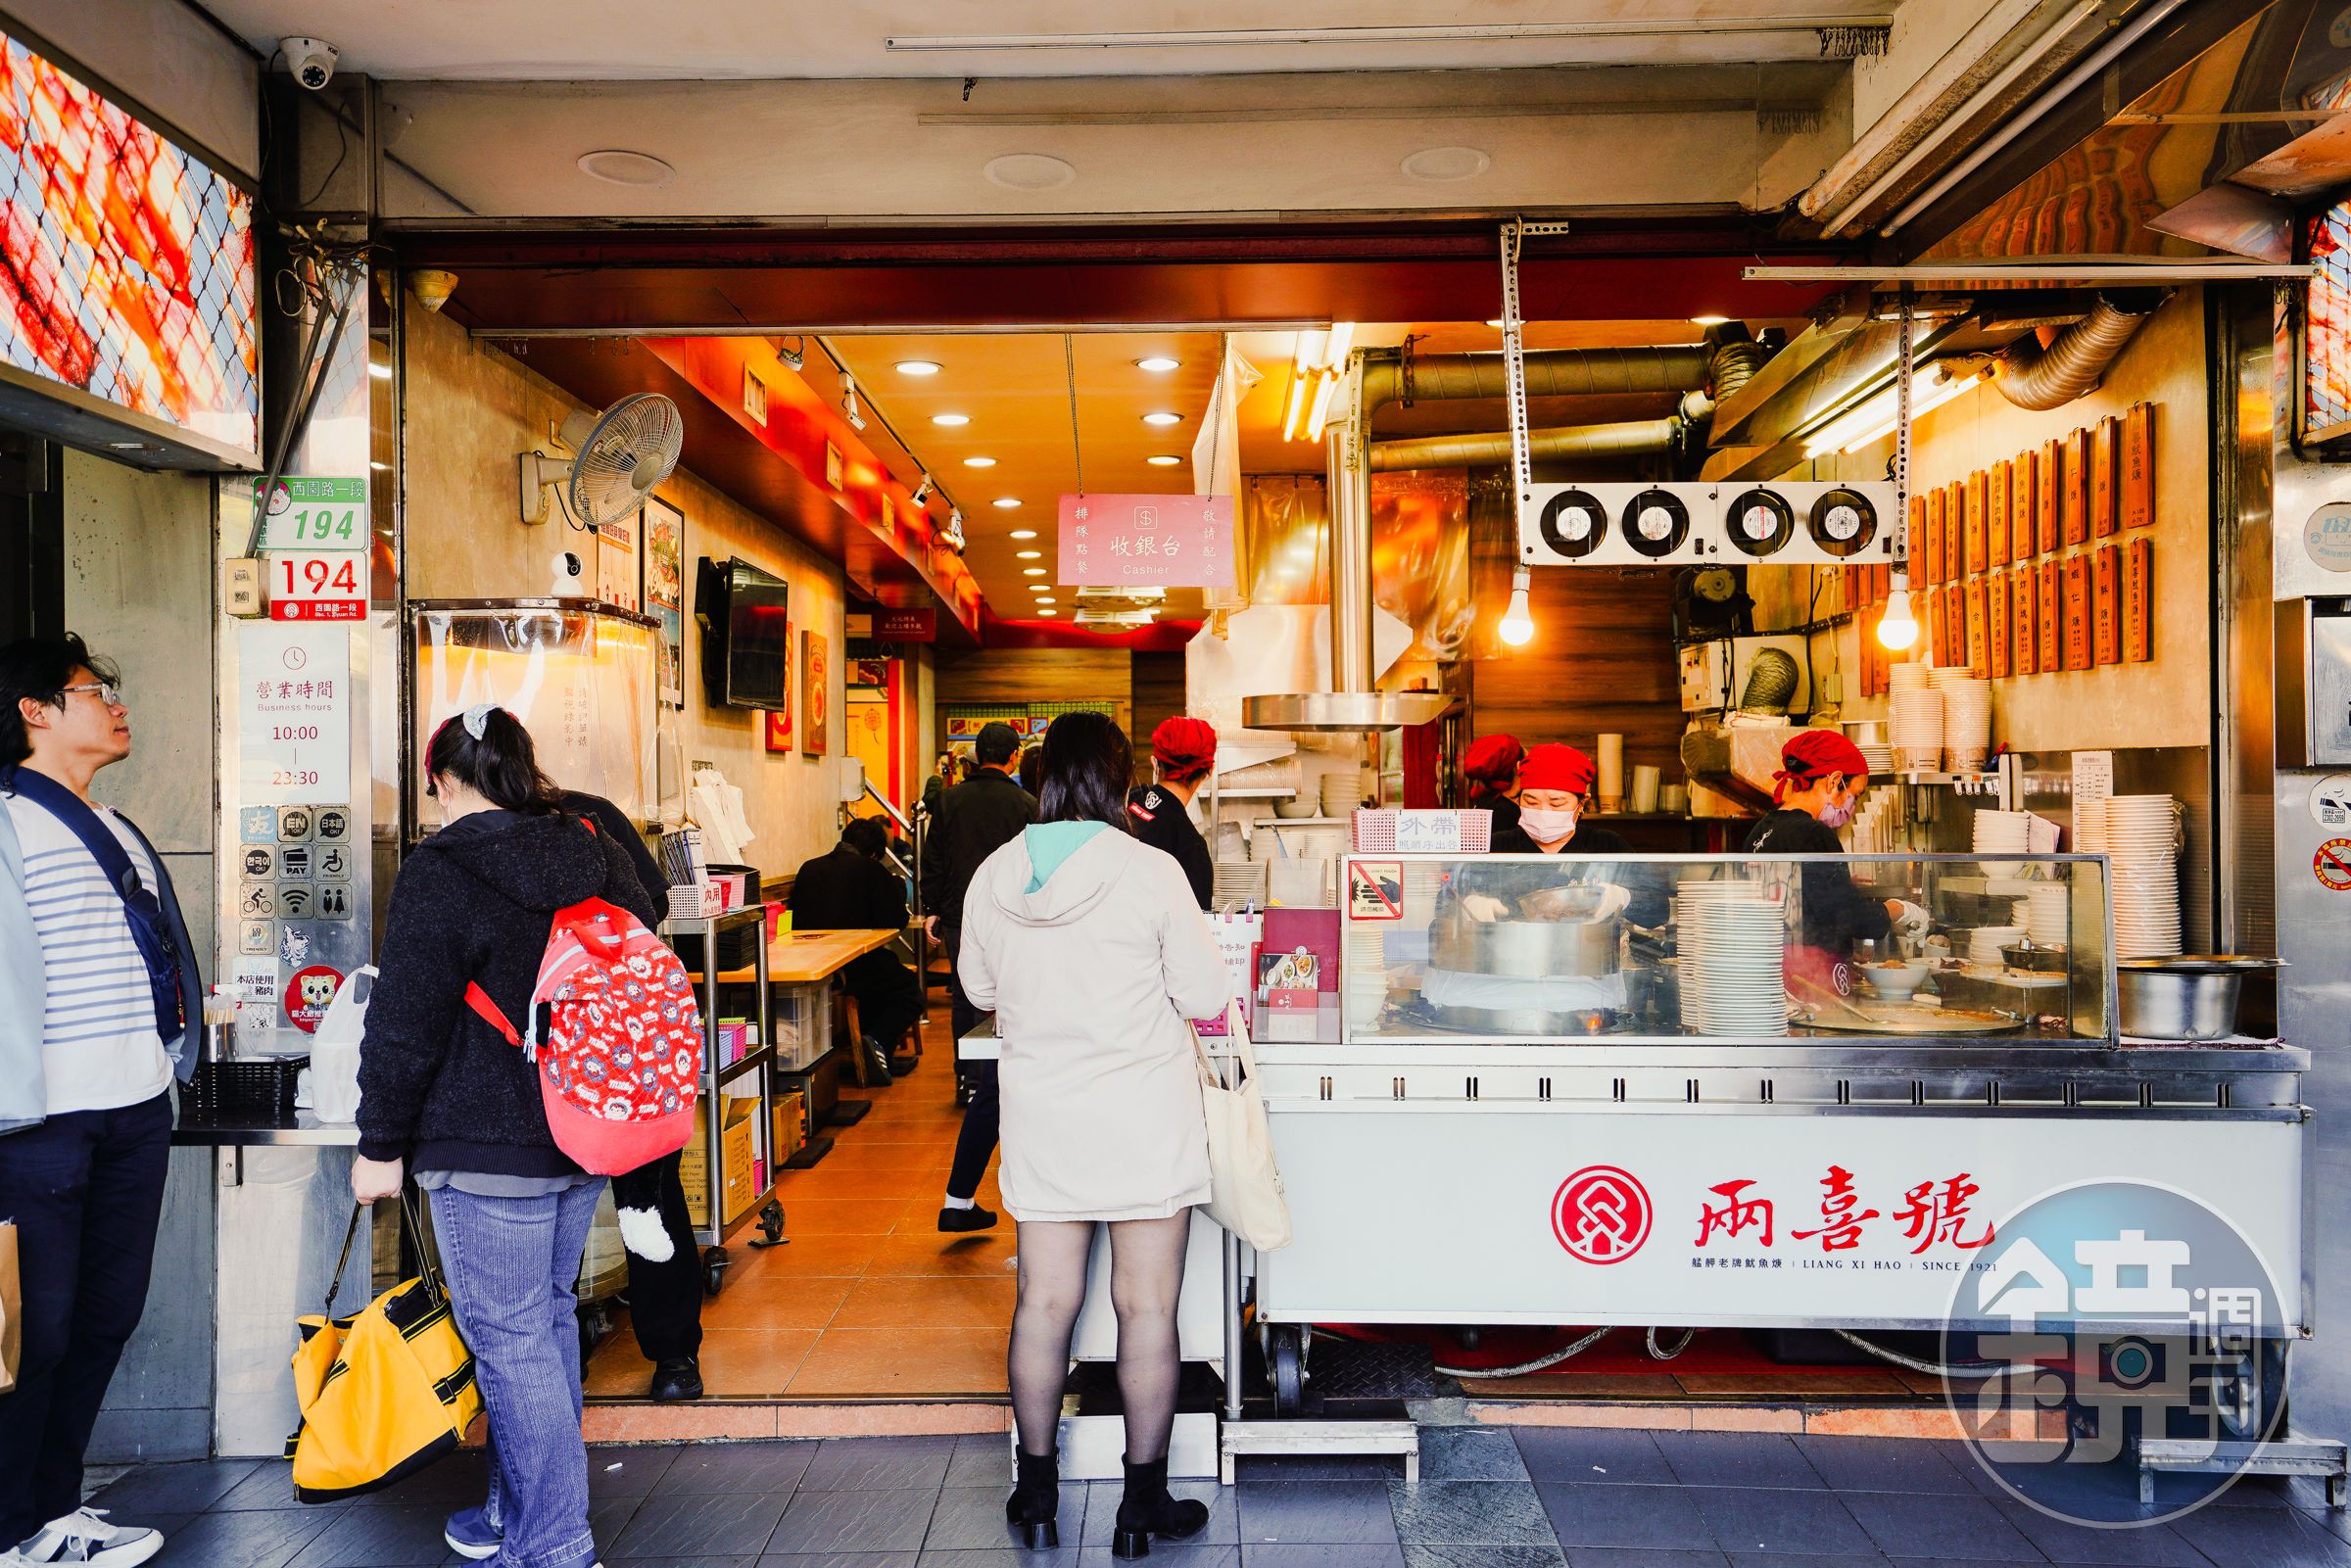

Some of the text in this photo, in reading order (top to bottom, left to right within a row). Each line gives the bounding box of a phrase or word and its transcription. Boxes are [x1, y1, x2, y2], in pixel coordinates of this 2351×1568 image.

[293, 481, 363, 498] 西園路一段
[294, 510, 354, 540] 194
[1075, 506, 1089, 575] 排隊點餐
[1110, 535, 1180, 557] 收銀台
[1202, 509, 1217, 576] 敬請配合
[1123, 564, 1170, 575] Cashier
[281, 559, 357, 595] 194
[256, 680, 333, 699] 營業時間
[258, 703, 332, 712] Business hours
[273, 727, 318, 740] 10:00
[272, 771, 318, 785] 23:30
[286, 817, 307, 829] EN
[321, 818, 344, 829] 日本語
[1400, 816, 1457, 835] 外帶
[247, 856, 270, 867] 한국어
[236, 974, 274, 985] 本店使用
[255, 985, 273, 996] 豬肉
[1695, 1165, 1995, 1255] 兩喜號
[1692, 1258, 1782, 1268] 艋舺老牌魷魚焿
[1803, 1259, 1843, 1268] LIANG
[1874, 1260, 1901, 1269] HAO
[1922, 1261, 1960, 1270] SINCE
[1970, 1262, 1996, 1271] 1921
